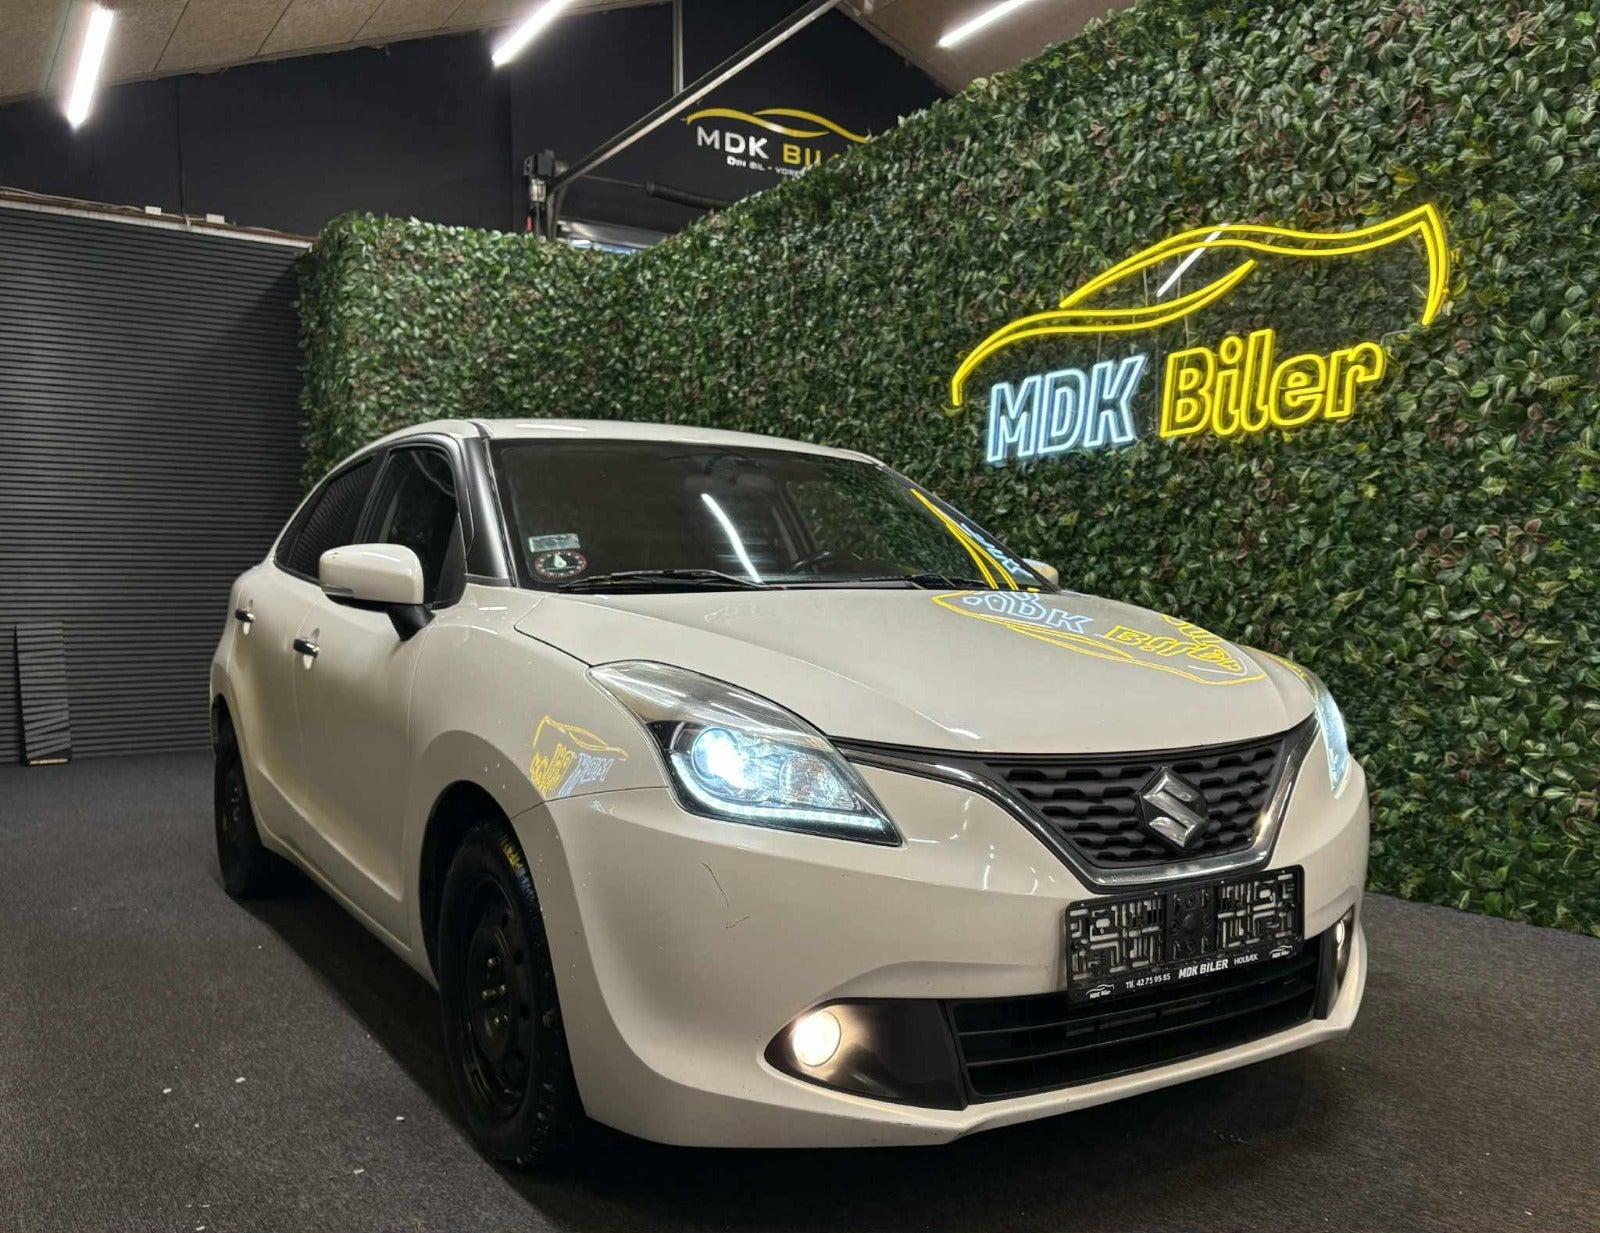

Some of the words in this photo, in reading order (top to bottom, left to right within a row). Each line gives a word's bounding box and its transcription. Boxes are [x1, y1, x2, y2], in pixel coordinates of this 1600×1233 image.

[697, 126, 769, 159] MDK
[986, 353, 1149, 464] MDK
[1159, 328, 1386, 440] Biler
[1178, 965, 1199, 979] MDK
[1199, 959, 1229, 975] BILER
